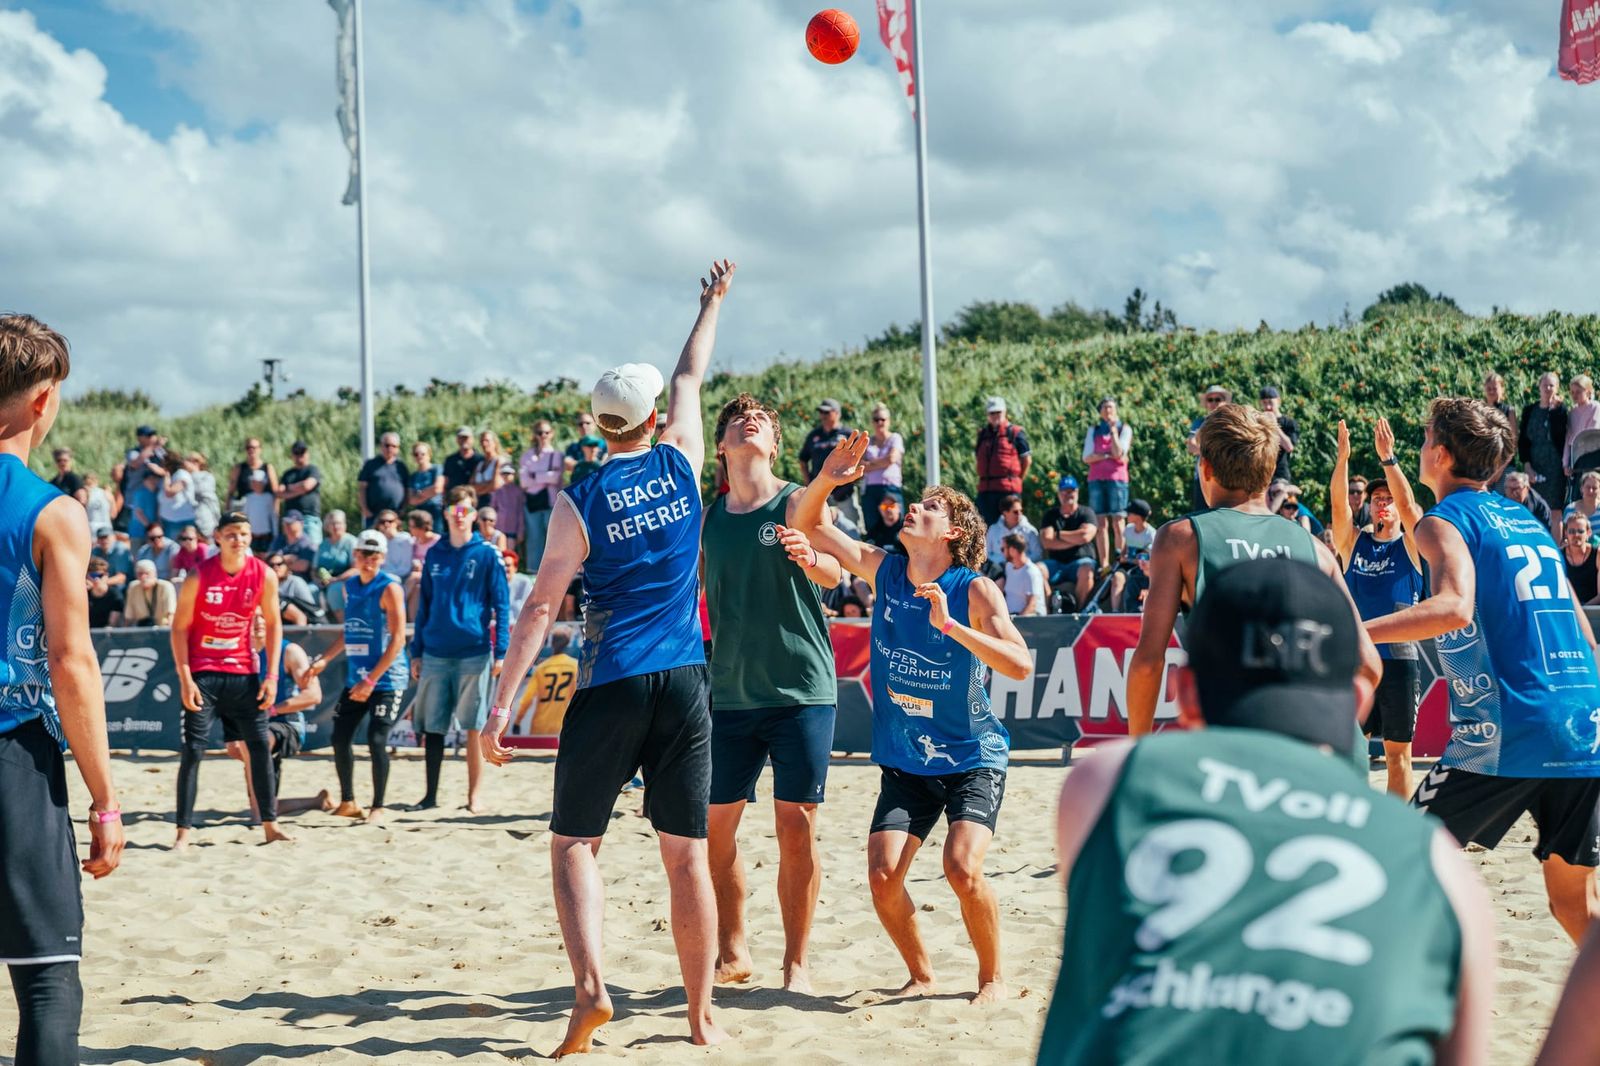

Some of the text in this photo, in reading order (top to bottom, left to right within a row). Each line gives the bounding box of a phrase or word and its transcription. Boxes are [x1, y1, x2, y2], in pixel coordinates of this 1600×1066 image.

[606, 473, 677, 513] BEACH
[606, 496, 691, 544] REFEREE
[1505, 545, 1570, 602] 27
[540, 671, 574, 703] 32
[889, 661, 952, 680] FORMEN
[889, 672, 951, 691] Schwanewede
[1197, 757, 1371, 829] TVoll
[1124, 818, 1388, 966] 92
